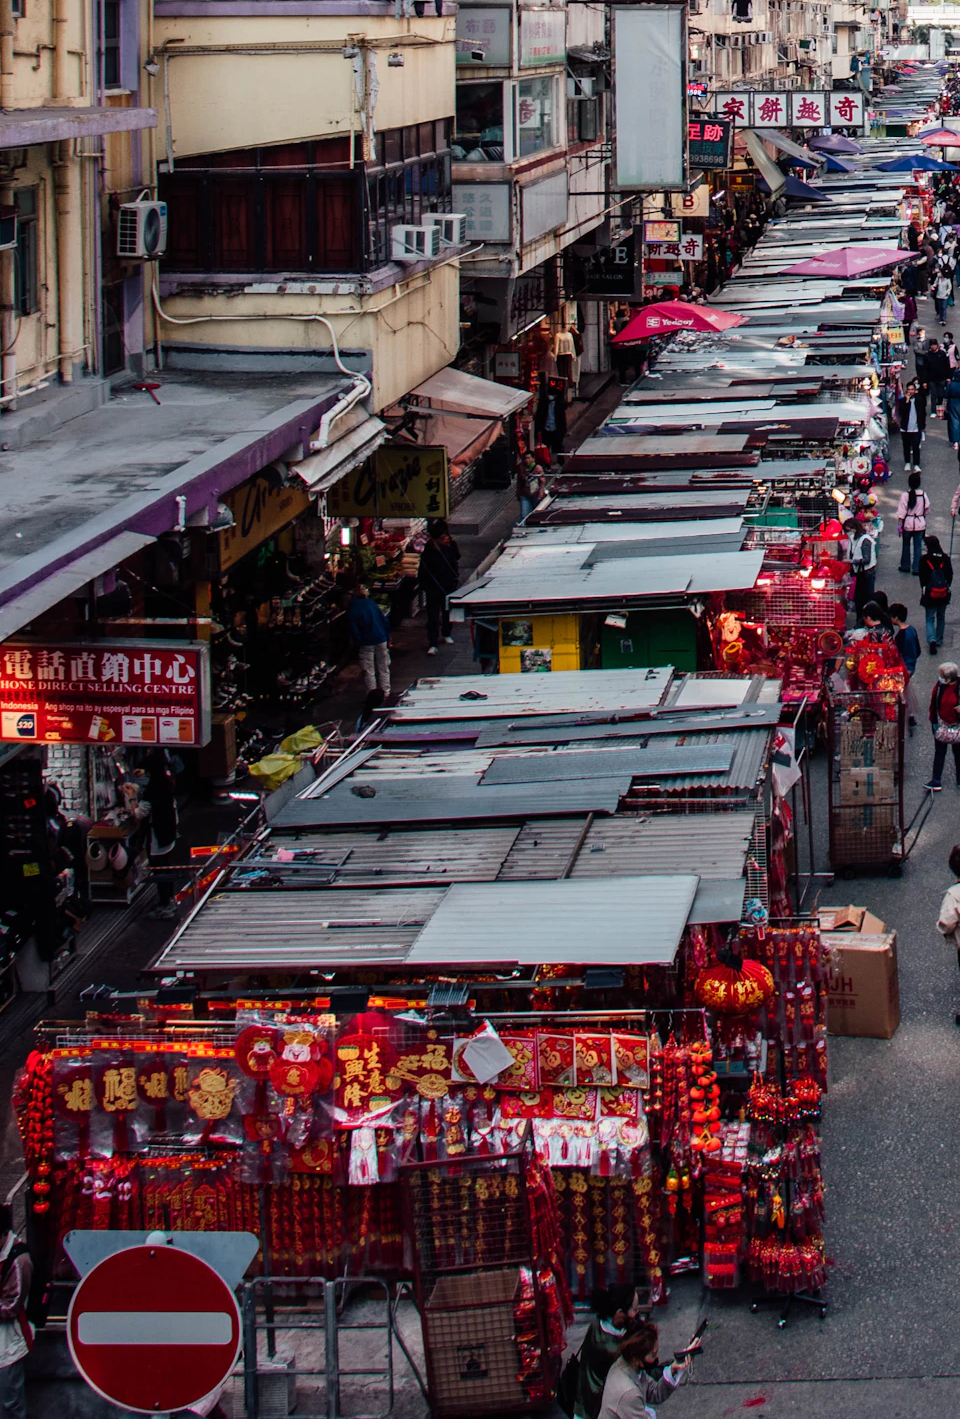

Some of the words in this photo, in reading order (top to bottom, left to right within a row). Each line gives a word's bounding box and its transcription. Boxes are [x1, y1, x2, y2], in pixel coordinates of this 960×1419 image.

[0, 648, 196, 684] 電話直銷中心
[38, 680, 85, 692] DIRECT
[87, 682, 142, 693] SELLING
[143, 684, 196, 695] CENTRE
[1, 702, 38, 710] Indonesia
[44, 702, 58, 713] Ang
[58, 704, 75, 713] shop
[84, 704, 93, 712] ito
[94, 706, 102, 714] ay
[103, 705, 131, 714] espesyal
[132, 706, 146, 715] para
[156, 707, 170, 716] mga
[171, 706, 195, 715] Filipino
